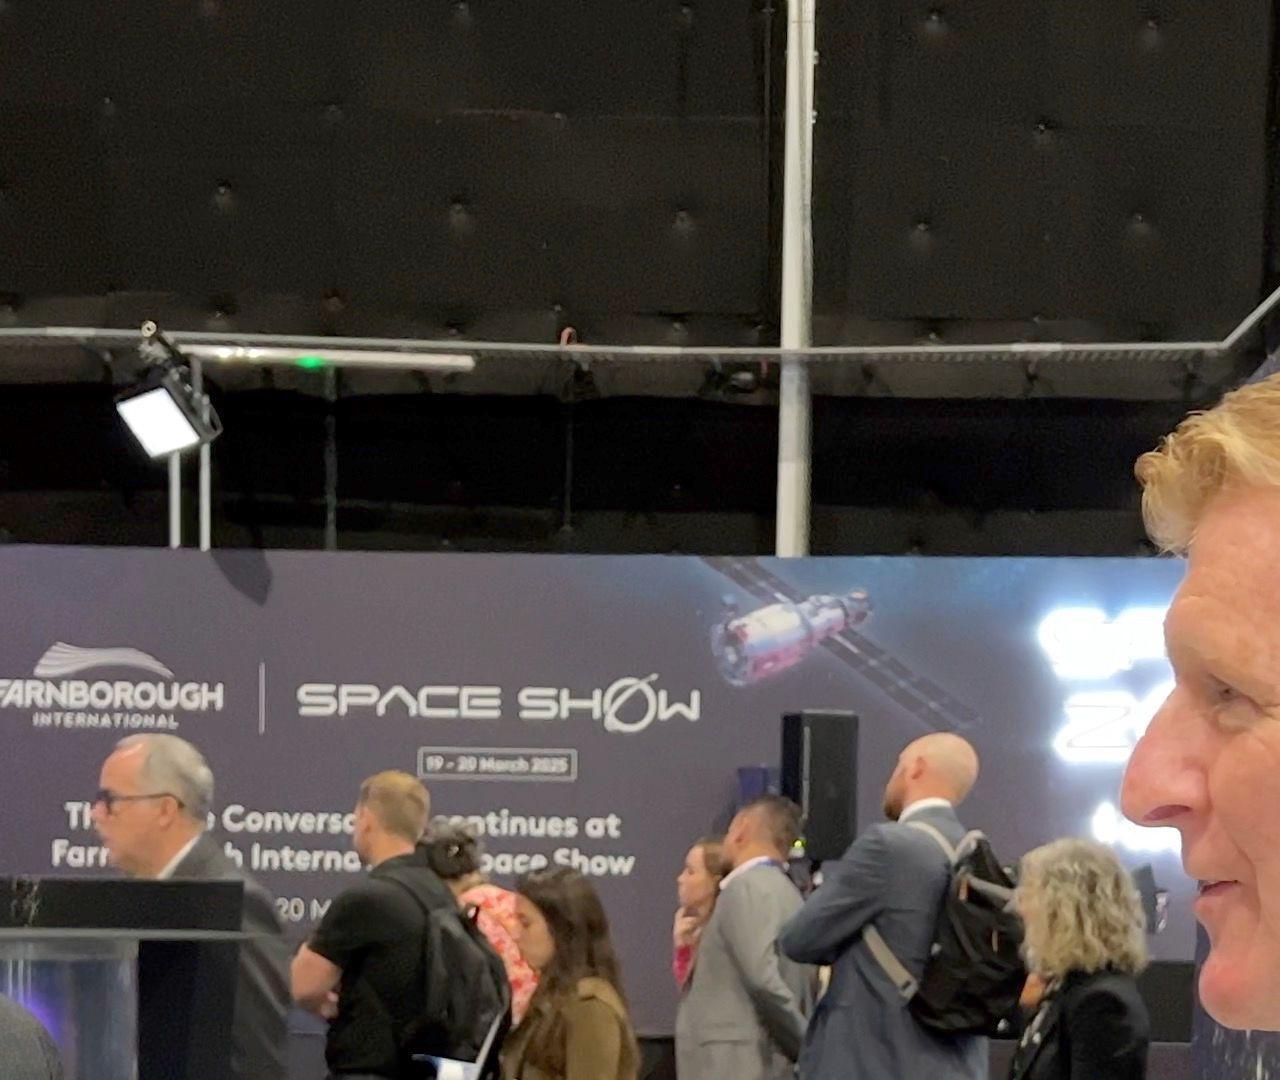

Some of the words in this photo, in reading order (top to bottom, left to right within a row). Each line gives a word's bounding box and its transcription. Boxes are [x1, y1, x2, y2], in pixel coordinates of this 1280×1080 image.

[297, 683, 501, 717] SPACE
[518, 673, 701, 732] SHOW
[32, 711, 180, 730] INTERNATIONAL
[480, 754, 529, 775] March
[585, 813, 622, 839] at
